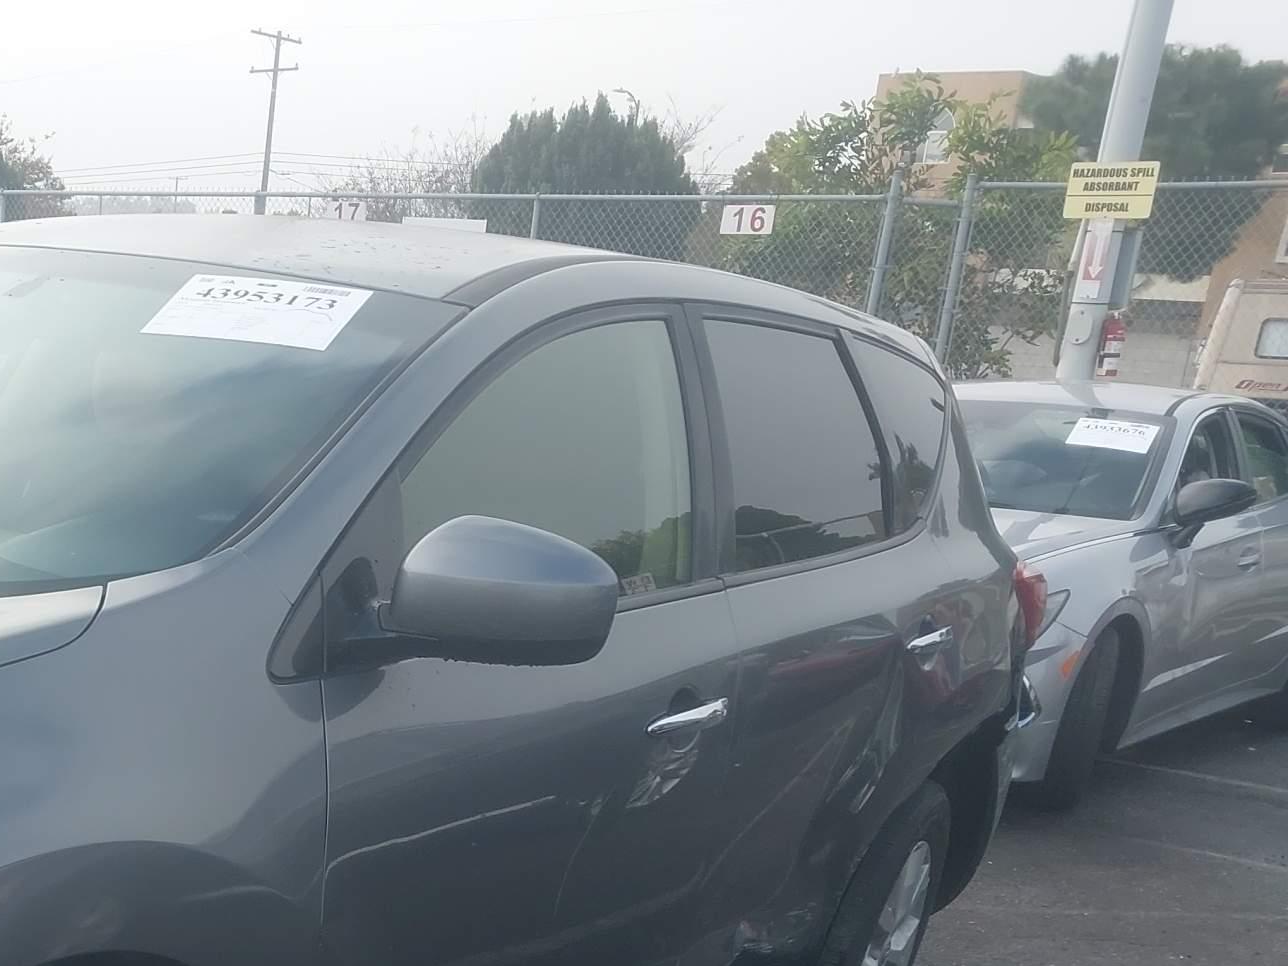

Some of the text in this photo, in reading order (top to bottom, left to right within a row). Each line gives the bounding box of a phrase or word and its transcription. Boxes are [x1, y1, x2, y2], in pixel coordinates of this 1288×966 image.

[1072, 167, 1155, 178] HAZARDOUS SPILL
[1082, 181, 1140, 192] ABSORBANT
[333, 202, 361, 221] 17
[1084, 202, 1129, 213] DISPOSAL
[732, 202, 766, 233] 16
[196, 287, 339, 311] 43953173
